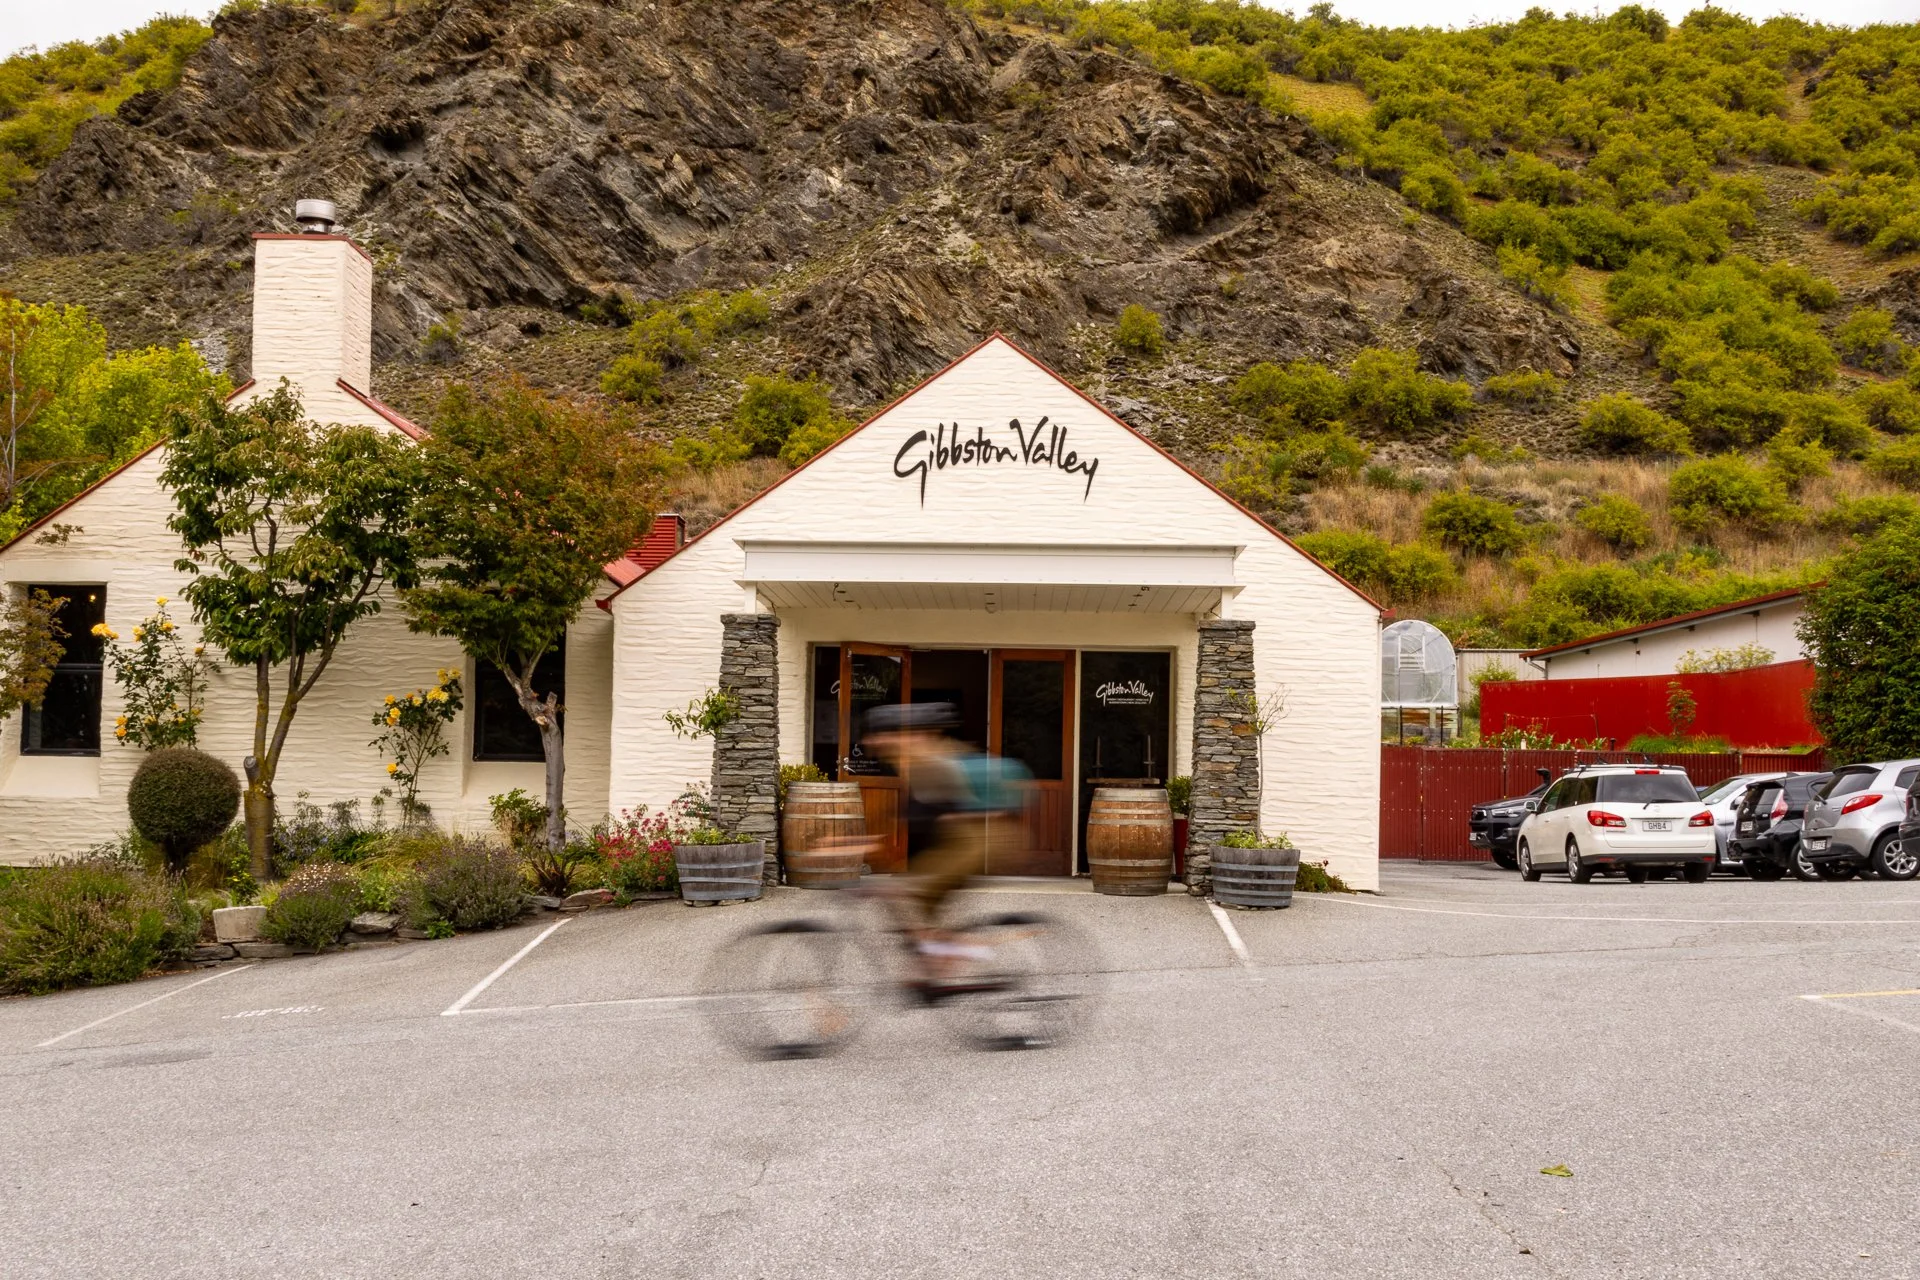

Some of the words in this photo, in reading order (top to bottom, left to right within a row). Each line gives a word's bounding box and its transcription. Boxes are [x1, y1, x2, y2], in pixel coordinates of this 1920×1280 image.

[893, 421, 1018, 510] Gibbston
[1009, 415, 1099, 504] Valley
[830, 679, 866, 702] Gston
[862, 675, 889, 698] Valley
[1095, 681, 1131, 707] Gibbston
[1127, 679, 1154, 704] Valley
